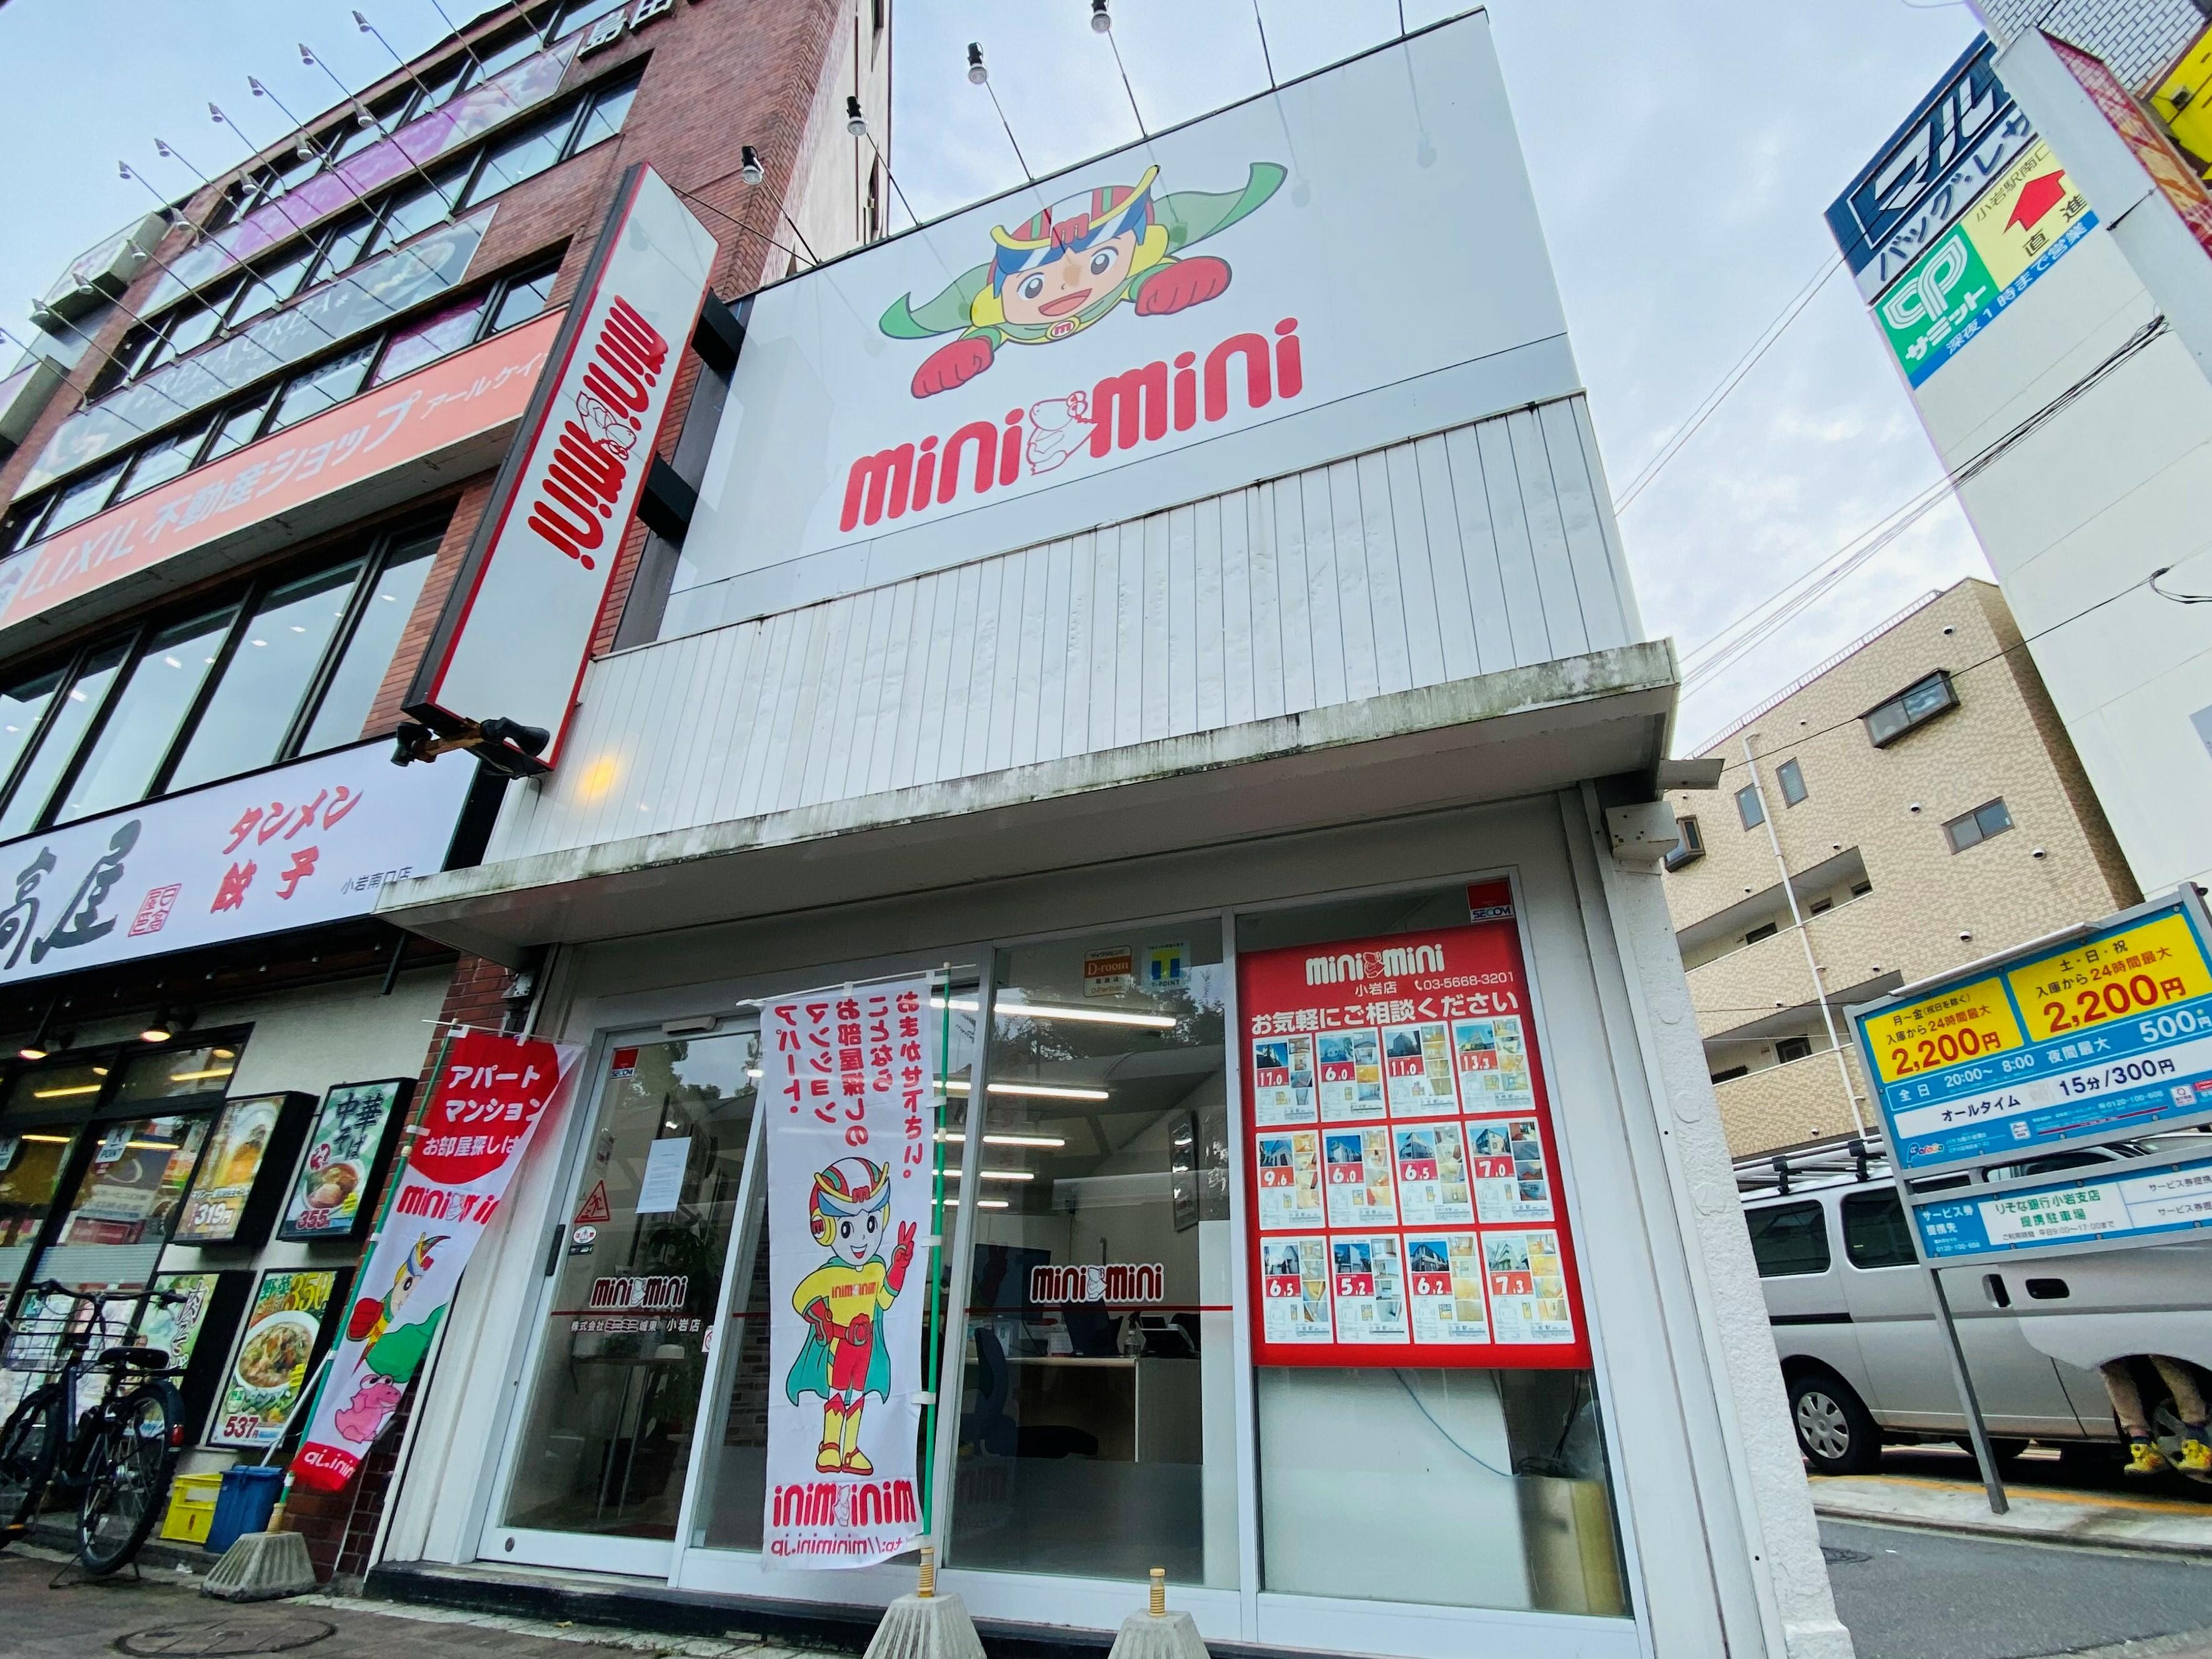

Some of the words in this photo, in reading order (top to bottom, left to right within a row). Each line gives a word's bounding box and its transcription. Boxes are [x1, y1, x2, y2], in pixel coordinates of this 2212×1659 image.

[1875, 77, 2010, 211] マル
[1976, 144, 2053, 222] 小岩駅南口
[2023, 193, 2086, 257] 直進
[1946, 222, 2089, 355] 深夜1時まで営業
[1905, 285, 1986, 361] サミット
[21, 518, 134, 601] LIXIL
[142, 389, 424, 546] 不動産ショップ
[223, 785, 364, 855] タンメン
[210, 845, 320, 914] 餃子
[341, 866, 413, 895] 小岩南口店
[1473, 905, 1511, 919] SECOM
[2059, 939, 2129, 972] 土・日・祝
[1354, 980, 1398, 998] 小岩店
[1423, 971, 1514, 992] 03-5668-3201
[1251, 991, 1519, 1036] お気軽にご相談ください
[2043, 974, 2187, 1033] 2,200円
[1891, 1027, 2001, 1076] 2,200円
[2002, 1054, 2035, 1074] 8:00
[2046, 1037, 2111, 1064] 夜間最大
[2138, 1010, 2212, 1043] 500円
[1324, 1067, 1348, 1081] 6.0
[1463, 1055, 1490, 1070] 13.3
[448, 1064, 541, 1089] アパート
[1941, 1095, 2021, 1123] オールタイム
[2059, 1057, 2176, 1097] 15分/300円
[446, 1097, 541, 1123] マンション
[422, 1135, 521, 1157] お部屋探しは
[1264, 1170, 1288, 1187] 9.6
[1332, 1167, 1356, 1183] 6.0
[1405, 1164, 1430, 1181] 6.5
[1479, 1160, 1506, 1178] 7.0
[2020, 1208, 2086, 1228] 提携駐車場
[1269, 1279, 1294, 1297] 6.5
[1341, 1277, 1366, 1296] 5.2
[1416, 1275, 1444, 1295] 6.2
[1495, 1275, 1524, 1295] 7.3
[666, 1318, 701, 1332] 小岩店
